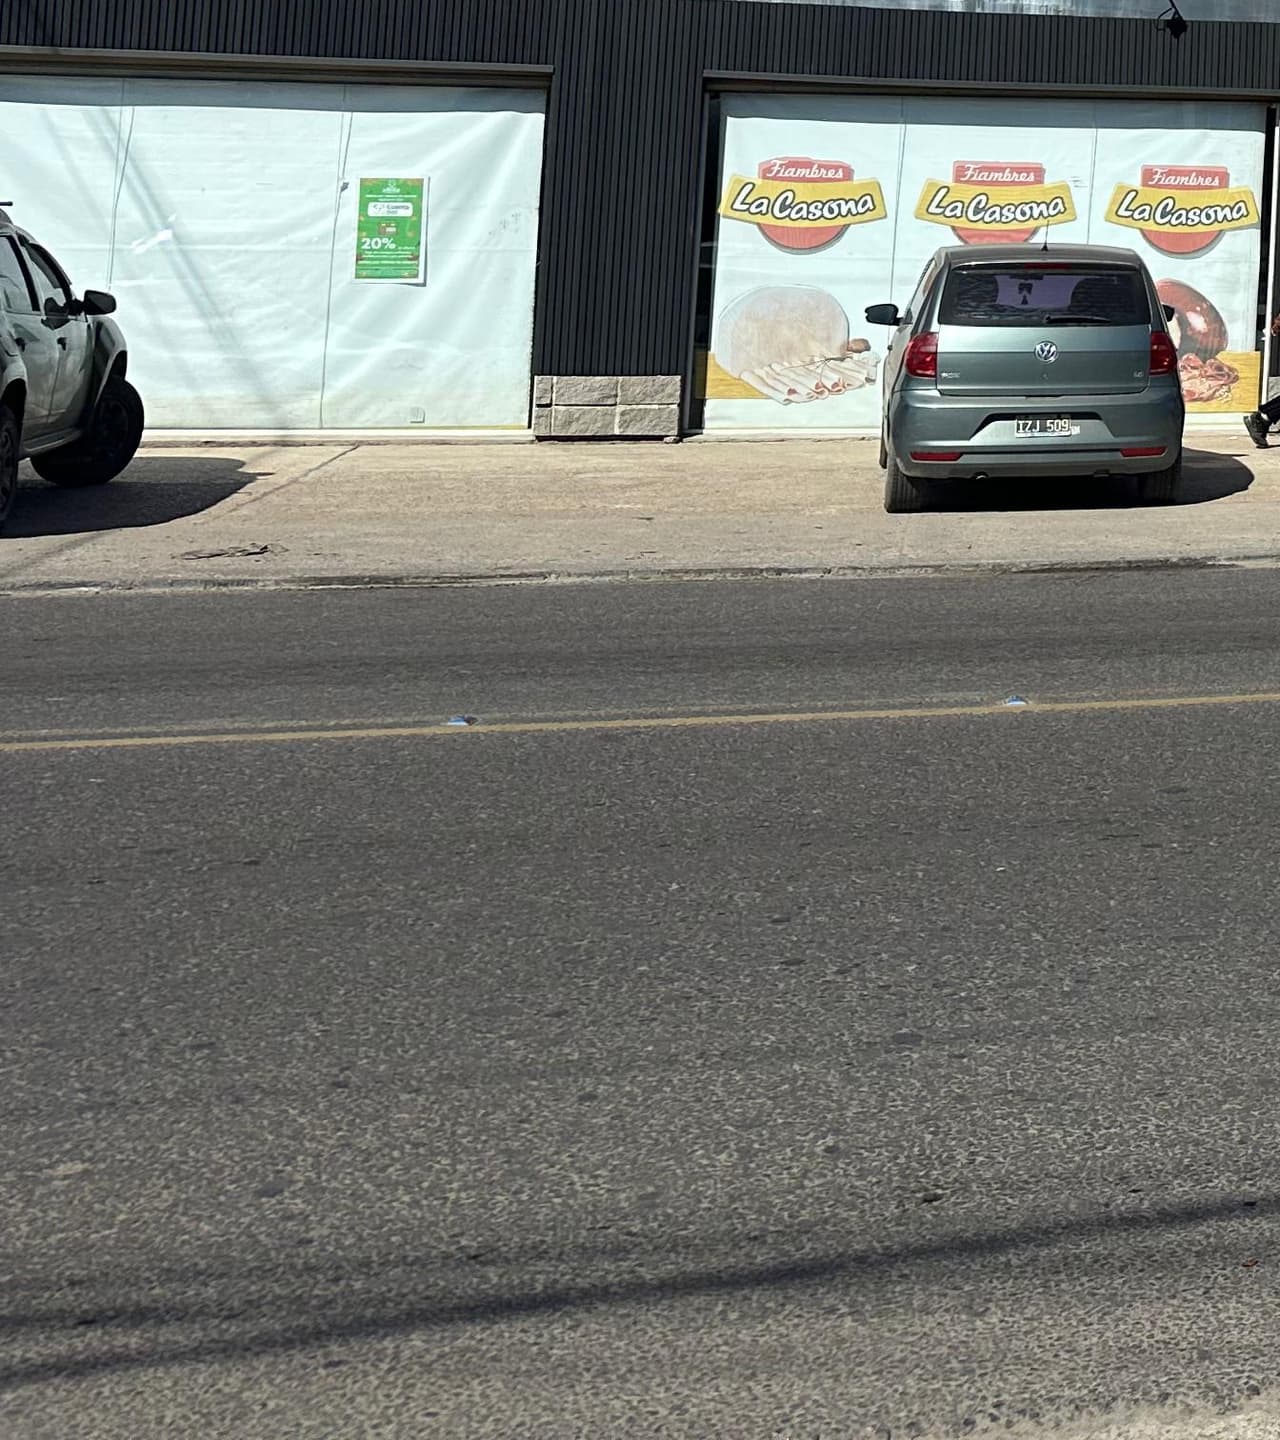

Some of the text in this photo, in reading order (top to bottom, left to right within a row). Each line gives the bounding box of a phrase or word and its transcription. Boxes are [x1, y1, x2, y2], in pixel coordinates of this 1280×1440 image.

[767, 160, 843, 178] Fiambres
[959, 164, 1035, 182] Fiambres
[1148, 168, 1220, 186] Fiambres
[731, 182, 876, 221] La Casona
[927, 186, 1067, 224] La Casona
[1115, 189, 1250, 227] La Casona
[361, 238, 397, 250] 20%
[1018, 418, 1070, 433] IZJ 509
